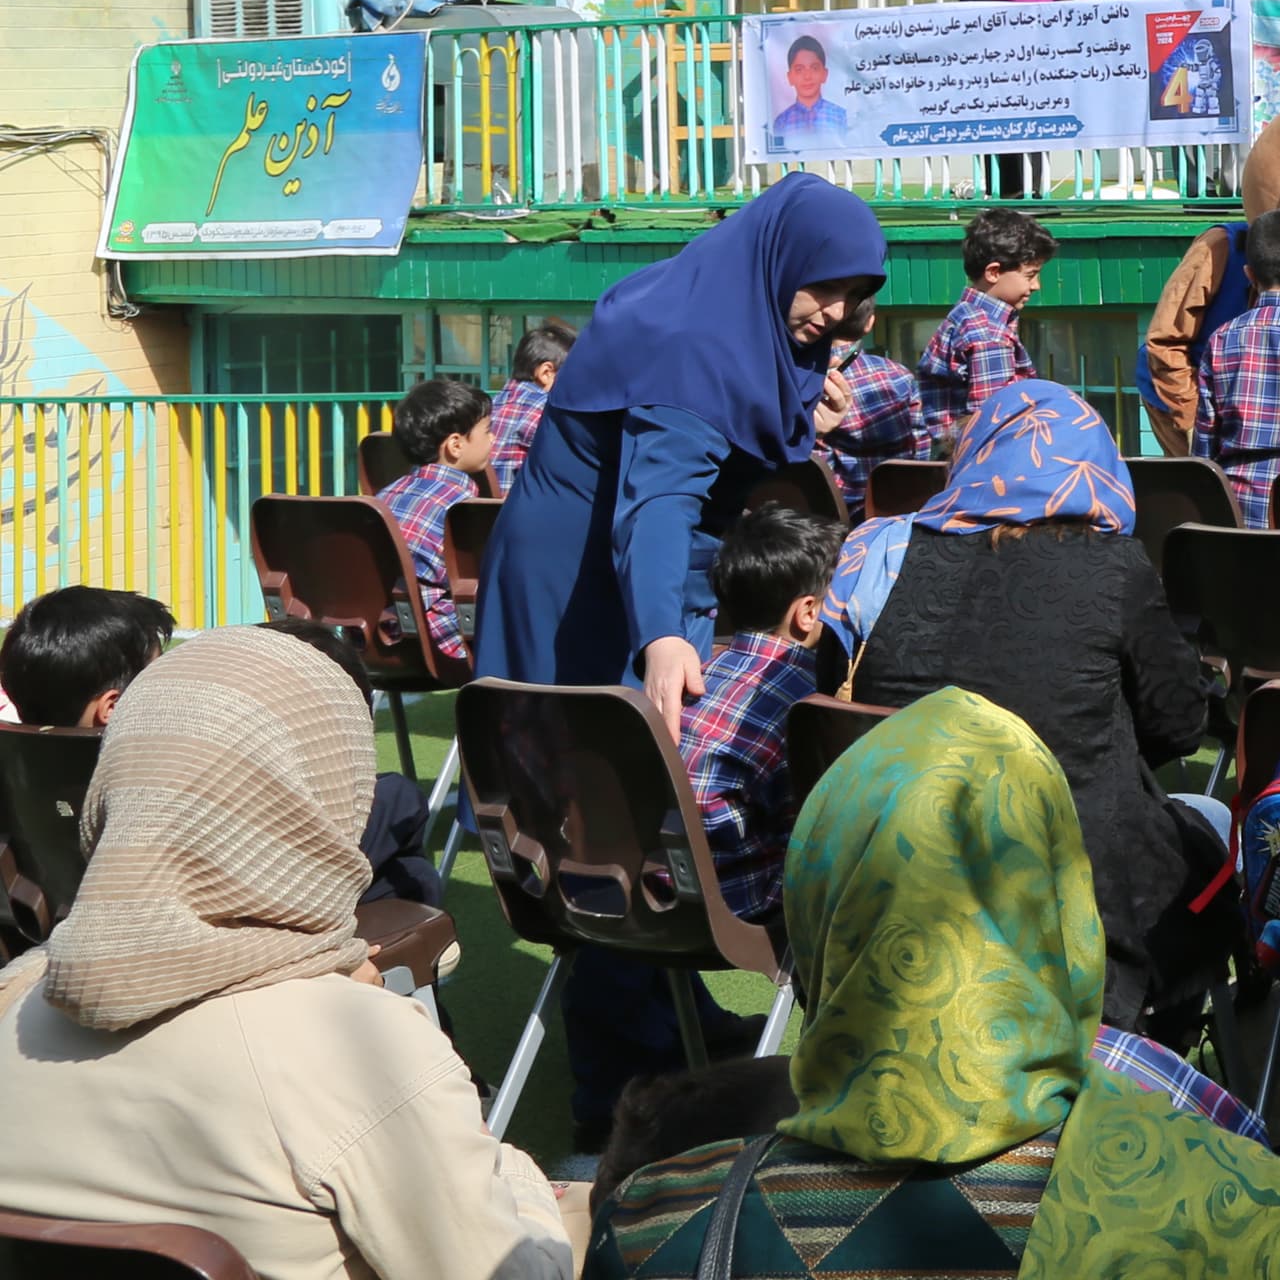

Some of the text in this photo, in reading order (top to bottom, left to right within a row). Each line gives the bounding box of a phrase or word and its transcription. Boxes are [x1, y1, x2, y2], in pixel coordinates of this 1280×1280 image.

[982, 10, 1008, 32] آقای
[1009, 11, 1036, 30] جناب
[1076, 4, 1099, 26] آموز
[1101, 5, 1129, 24] دانش
[904, 19, 939, 37] رشیدی
[940, 17, 961, 35] علی
[963, 15, 981, 34] امیر
[1016, 44, 1035, 61] اول
[1036, 44, 1056, 60] رتبه
[1056, 41, 1084, 56] کسب
[1092, 38, 1131, 53] موفقیت
[855, 53, 891, 71] کشوری
[893, 51, 933, 67] مسابقات
[934, 52, 958, 67] دوره
[1003, 48, 1015, 63] در
[990, 70, 1009, 84] شما
[1022, 70, 1032, 86] را
[1112, 63, 1147, 79] رباتیک
[844, 79, 861, 96] علم
[862, 76, 886, 94] آذین
[889, 75, 926, 93] خانواده
[935, 74, 956, 91] مادر
[966, 75, 982, 89] پدر
[1011, 74, 1022, 86] به
[1160, 67, 1193, 113] 4
[950, 104, 966, 114] می
[967, 96, 999, 113] تبریک
[1001, 94, 1035, 111] رباتیک
[1035, 98, 1062, 110] مربی
[892, 128, 910, 145] علم
[910, 124, 930, 144] آذین
[930, 125, 954, 144] دولتی
[1045, 121, 1078, 137] مدیریت
[205, 89, 352, 217] آذین علم
